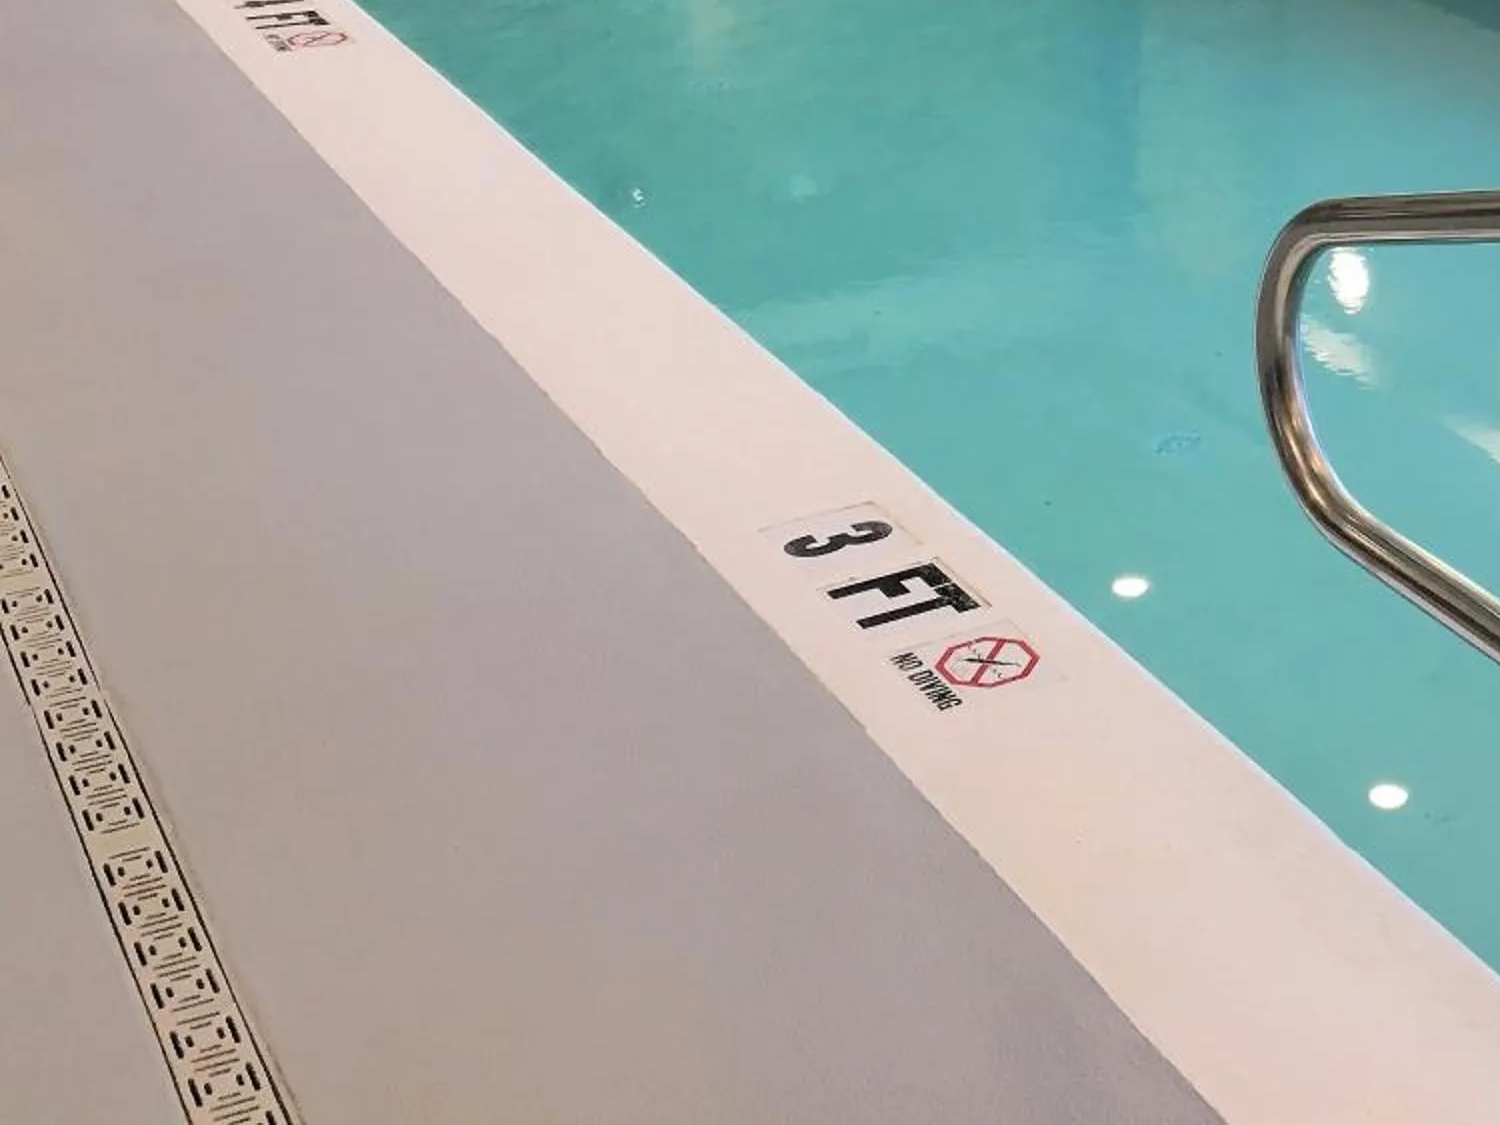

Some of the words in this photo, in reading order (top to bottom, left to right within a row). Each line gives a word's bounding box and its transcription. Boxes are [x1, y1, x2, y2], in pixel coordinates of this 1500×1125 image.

[783, 520, 893, 558] 3
[827, 562, 982, 630] FT
[890, 653, 923, 671] NO
[908, 669, 963, 712] DIVING
